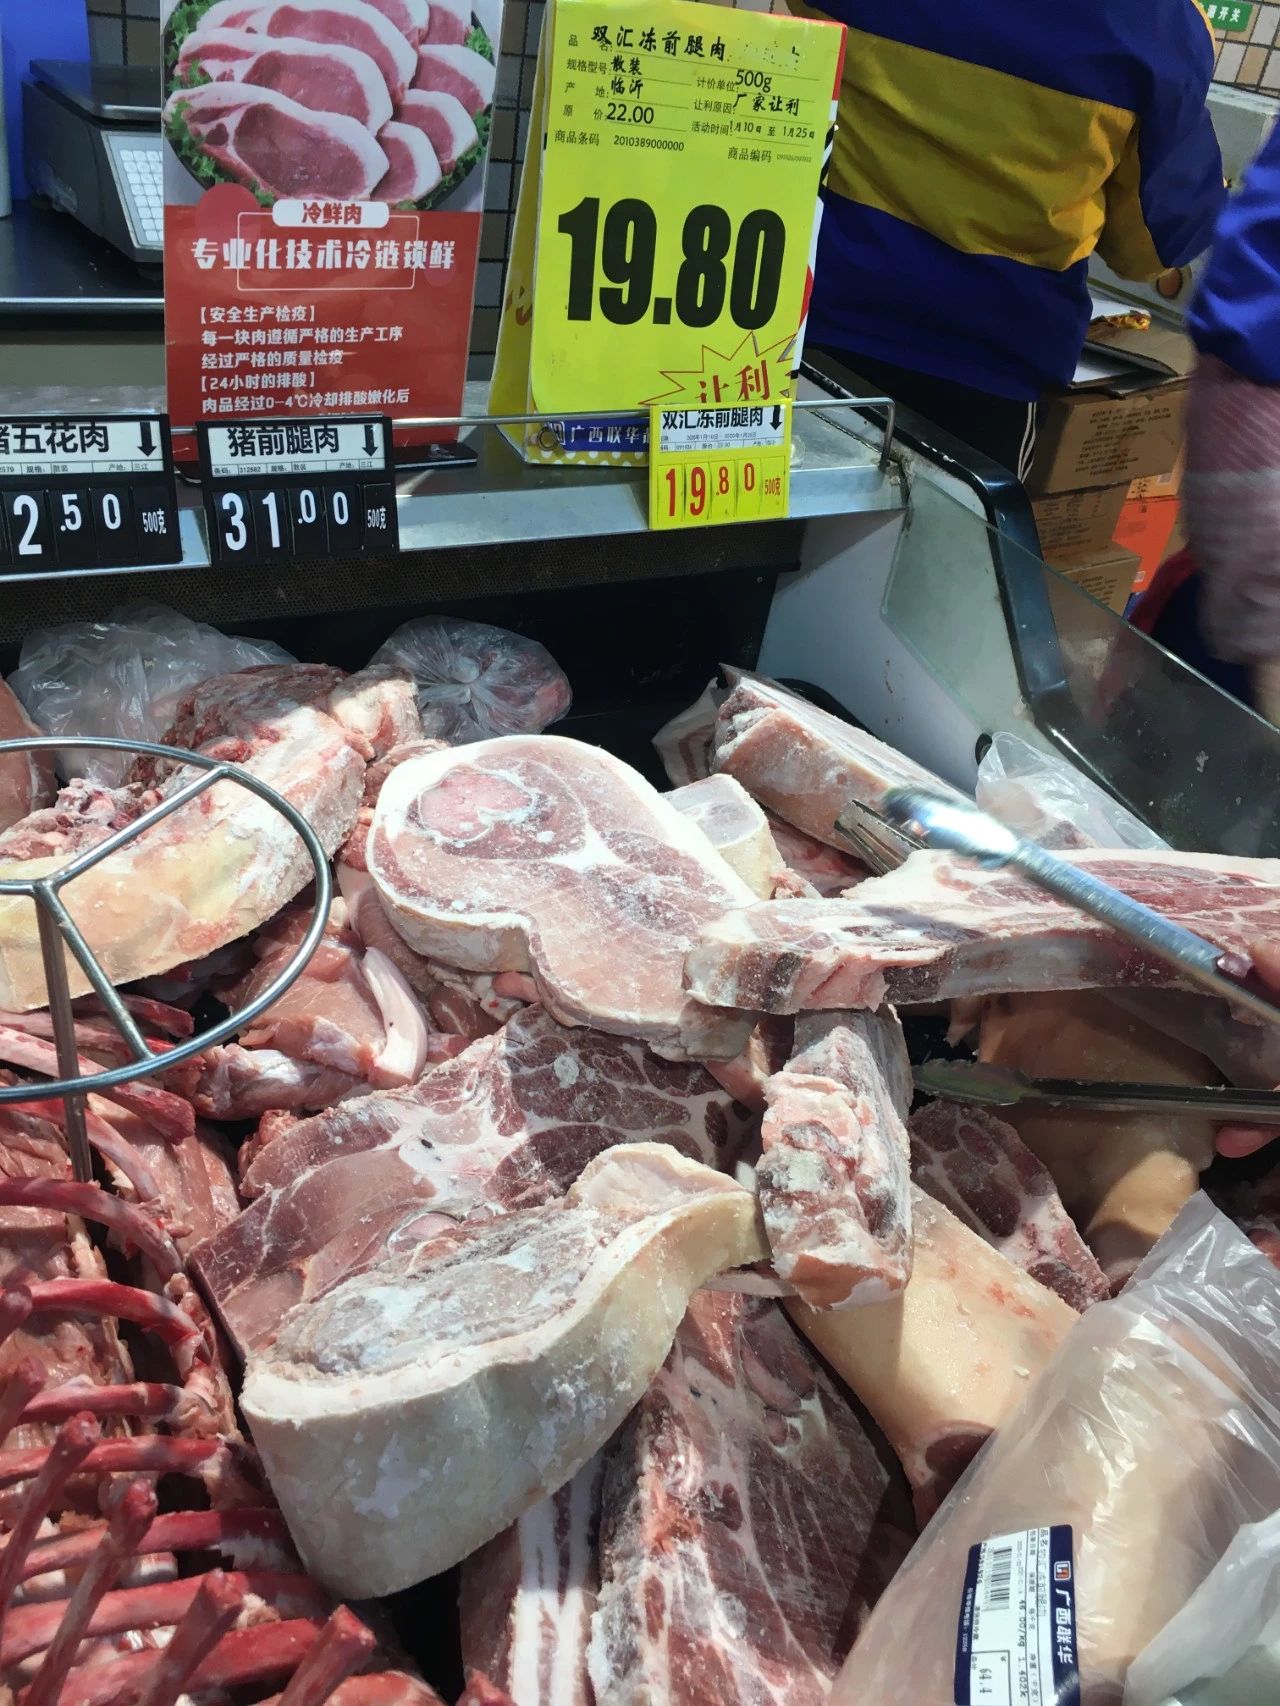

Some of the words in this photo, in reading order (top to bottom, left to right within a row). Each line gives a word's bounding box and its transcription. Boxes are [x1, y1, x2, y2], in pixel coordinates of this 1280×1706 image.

[591, 25, 726, 62] 双汇冻前腿肉
[611, 55, 643, 76] 散装
[611, 76, 644, 99] 临沂
[735, 69, 772, 93] 500g
[607, 102, 654, 124] 22.00
[733, 92, 799, 116] 厂家让利
[555, 130, 599, 146] 商品条码
[614, 135, 685, 151] 2010389000000
[728, 146, 772, 163] 商品编码
[302, 203, 362, 225] 冷鲜肉
[191, 237, 455, 270] 专业化技术冷链锁鲜
[557, 196, 786, 330] 19.80
[201, 325, 403, 347] 每一块肉遵循严格的生产工序
[201, 350, 344, 370] 经过严格的质量检疫
[695, 360, 771, 403] 让利
[662, 405, 764, 430] 双汇冻前腿肉
[227, 424, 339, 457] 猪前腿肉
[665, 462, 755, 517] 19.80
[764, 477, 782, 496] 500克
[142, 507, 167, 534] 500克
[222, 489, 349, 551] 31.00
[367, 507, 387, 530] 500克
[1055, 1588, 1073, 1664] 广西联华
